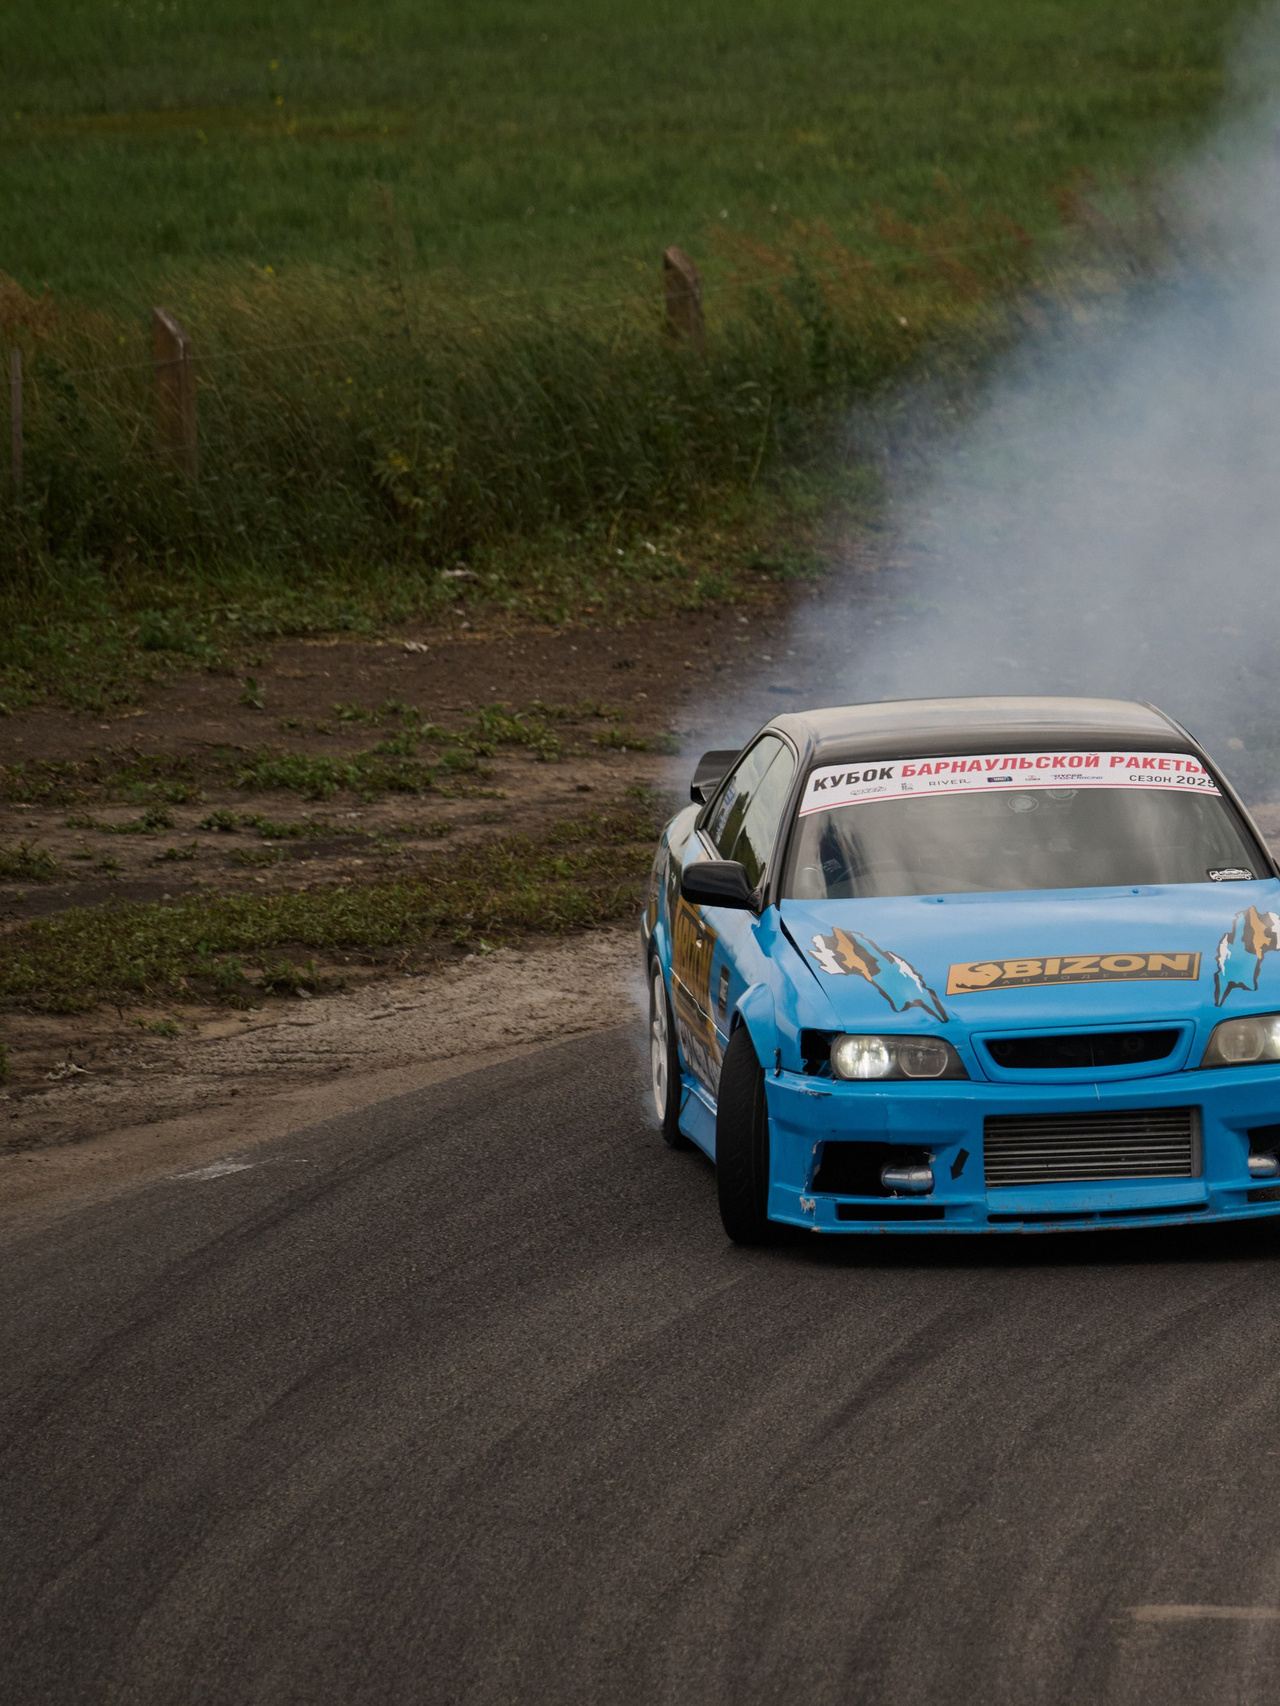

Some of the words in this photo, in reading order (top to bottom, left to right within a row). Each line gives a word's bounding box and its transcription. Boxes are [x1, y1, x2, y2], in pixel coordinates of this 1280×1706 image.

[813, 766, 895, 792] КУБОК
[901, 754, 1100, 777] БАРНАУЛЬСКОЙ
[1109, 756, 1208, 774] РАКЕТЫ
[1129, 774, 1172, 783] СЕЗОН
[1176, 775, 1217, 788] 2025
[1001, 954, 1190, 979] BIZON
[1002, 971, 1190, 985] АВТОДЕТАЛЬ
